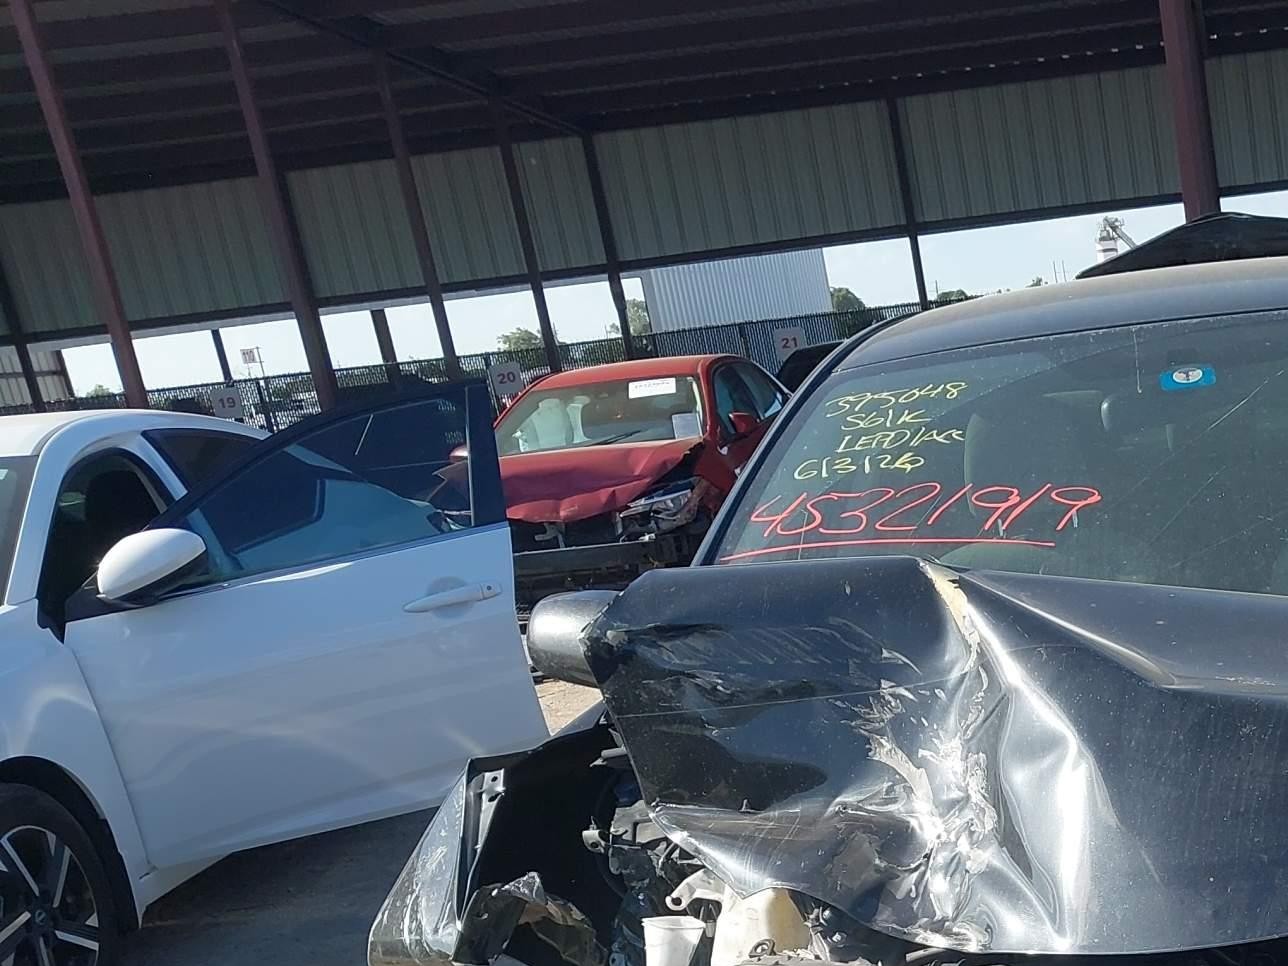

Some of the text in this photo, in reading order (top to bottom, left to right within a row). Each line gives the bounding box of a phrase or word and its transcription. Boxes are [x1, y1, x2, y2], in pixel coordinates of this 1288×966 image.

[781, 336, 798, 349] 21
[497, 371, 516, 385] 20
[219, 397, 237, 409] 19
[750, 482, 1103, 538] 45321919
